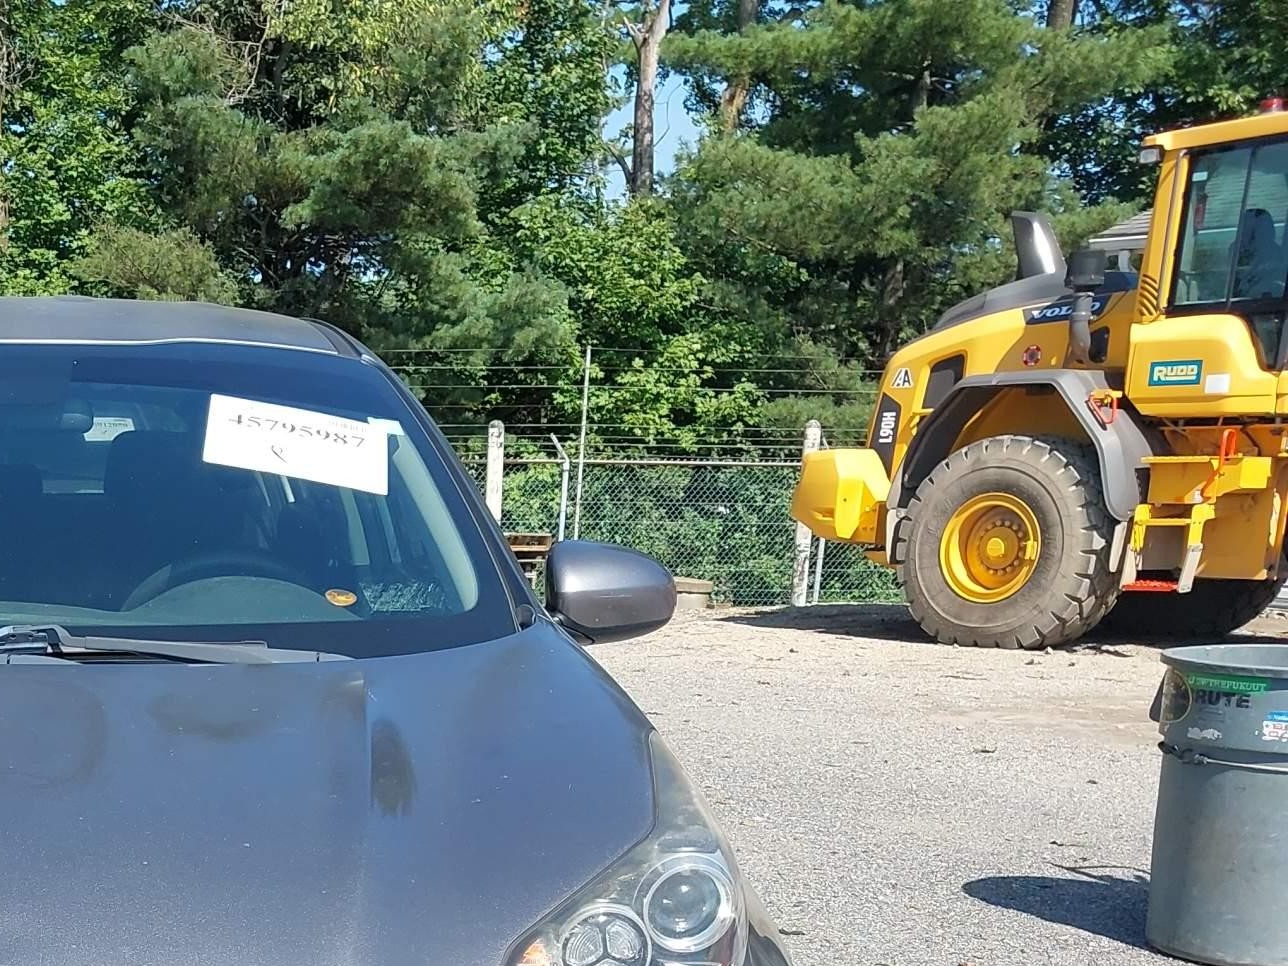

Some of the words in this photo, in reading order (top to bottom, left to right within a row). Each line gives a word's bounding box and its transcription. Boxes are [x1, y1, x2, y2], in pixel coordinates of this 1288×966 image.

[1031, 302, 1101, 319] VOLO
[1153, 364, 1198, 382] RUDD
[228, 413, 365, 448] 45795987
[878, 411, 897, 444] L90H
